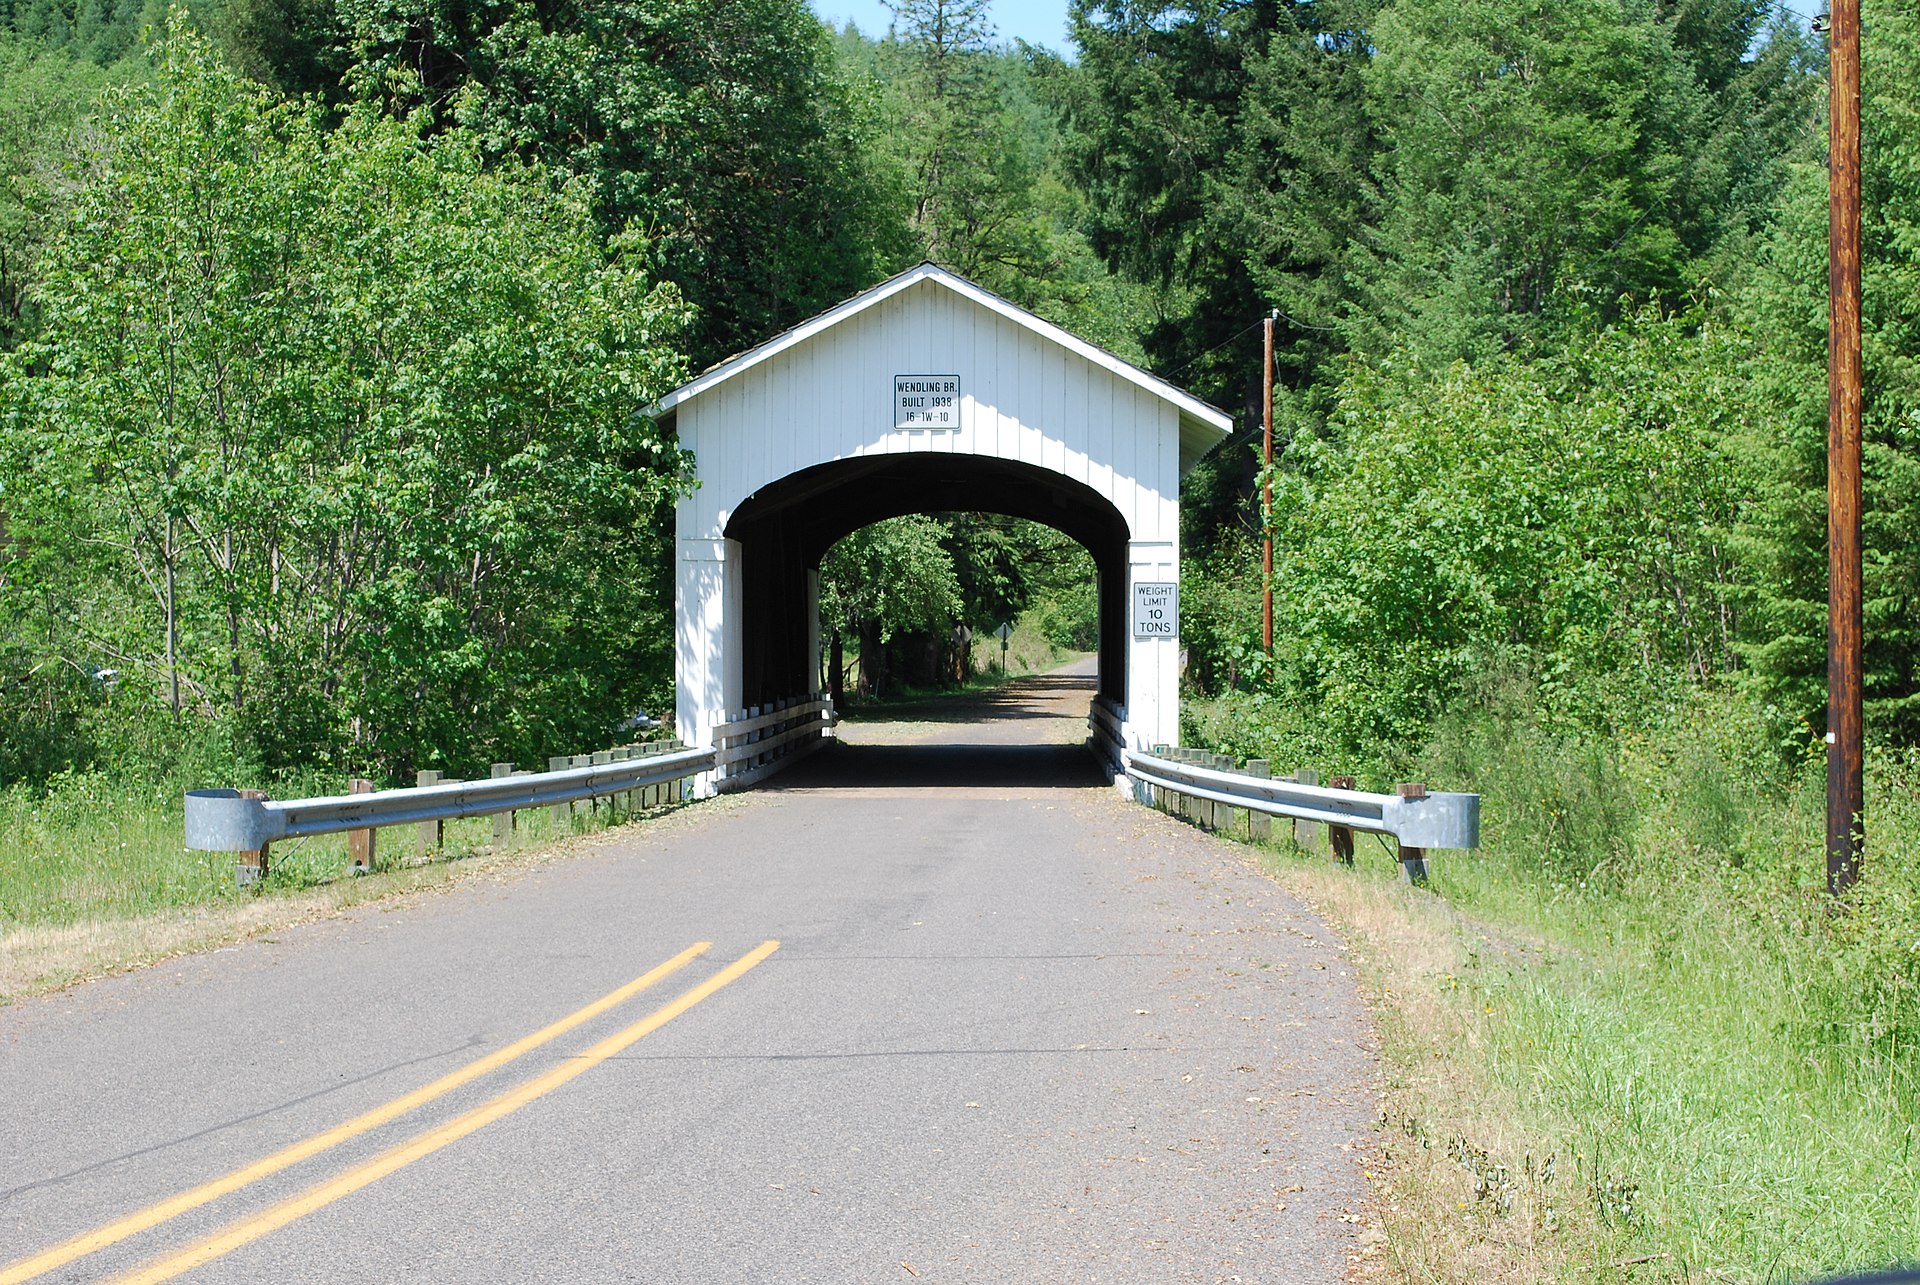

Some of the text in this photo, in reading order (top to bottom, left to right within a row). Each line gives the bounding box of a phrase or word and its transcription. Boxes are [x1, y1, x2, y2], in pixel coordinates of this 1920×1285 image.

[897, 382, 958, 393] WENDLING BR.
[902, 397, 952, 407] BUILT 1938
[906, 411, 949, 422] 16-1W-10
[1138, 586, 1173, 596] WEIGHT
[1143, 597, 1167, 606] LIMIT
[1148, 609, 1163, 619] 10
[1140, 622, 1171, 633] TONS
